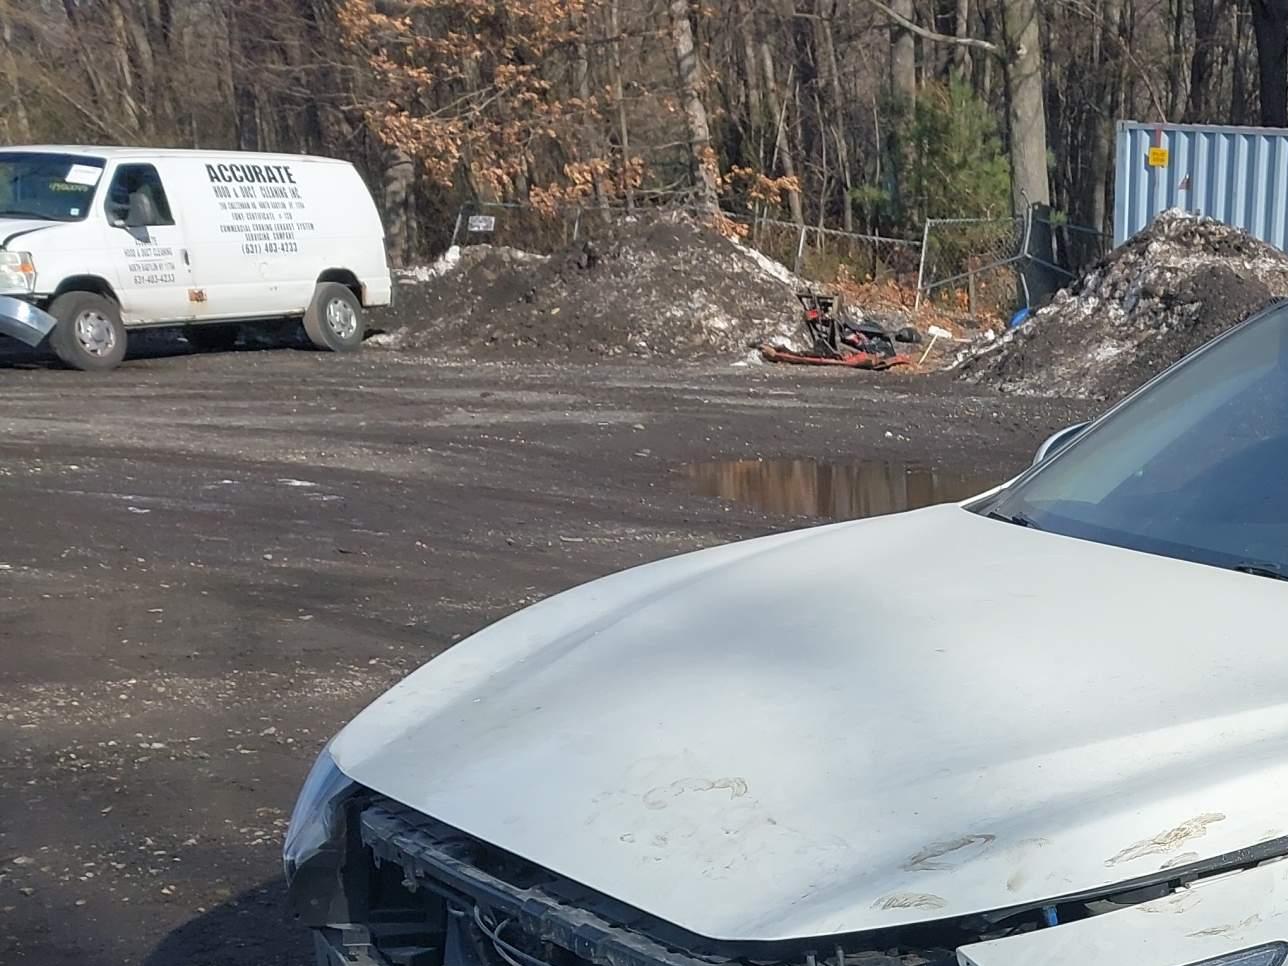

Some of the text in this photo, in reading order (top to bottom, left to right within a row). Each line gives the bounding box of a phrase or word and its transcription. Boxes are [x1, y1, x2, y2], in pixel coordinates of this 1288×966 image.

[205, 164, 297, 184] ACCURATE
[212, 186, 231, 198] HOOD
[239, 186, 257, 198] DUCT
[259, 186, 289, 198] CLEANING
[220, 224, 252, 232] COMMERCIAL
[295, 222, 314, 231] SYSTEM
[244, 232, 295, 241] SERVICING COMPANY
[241, 243, 262, 254] (631)
